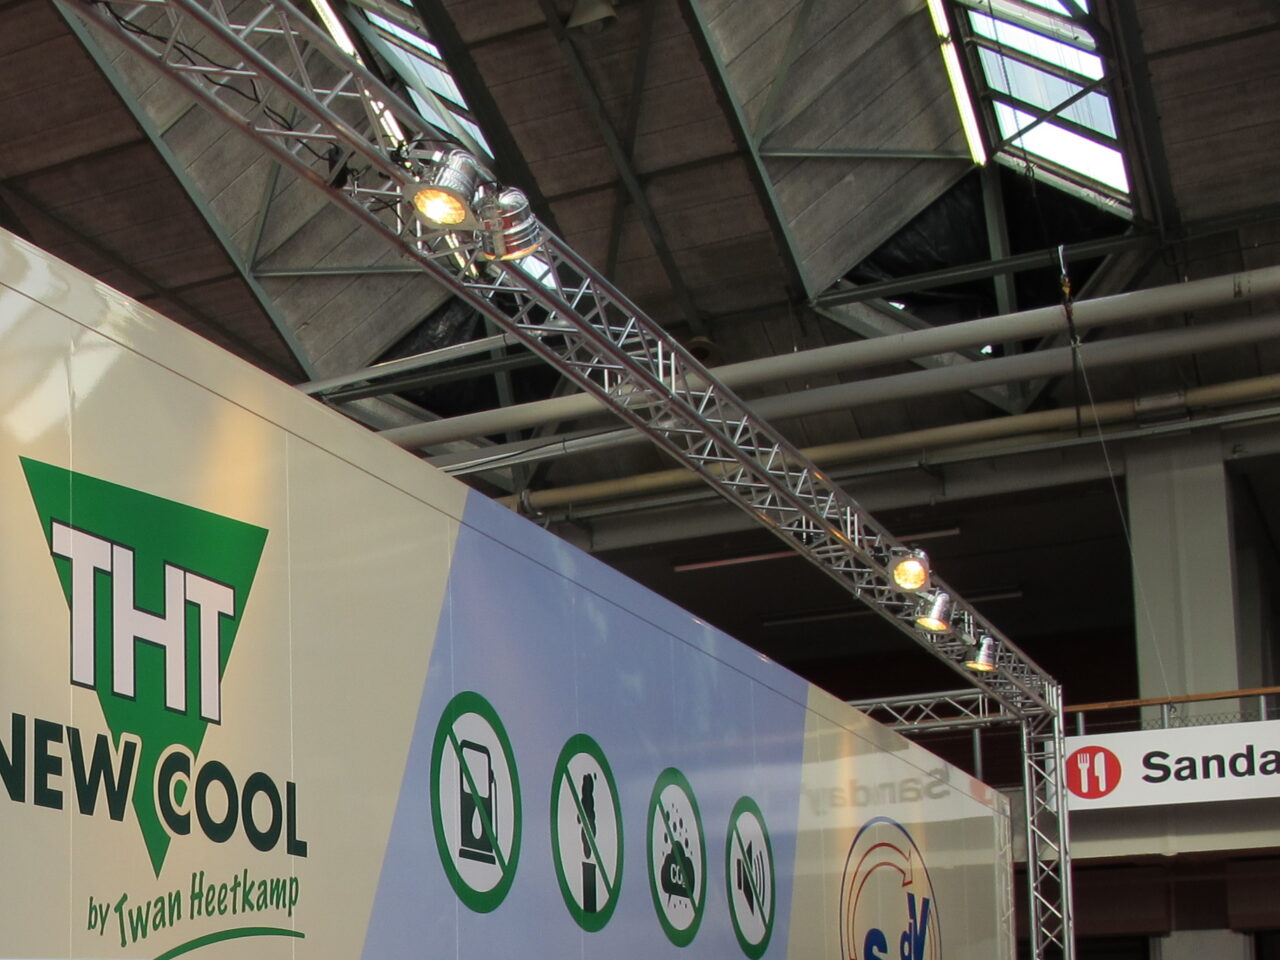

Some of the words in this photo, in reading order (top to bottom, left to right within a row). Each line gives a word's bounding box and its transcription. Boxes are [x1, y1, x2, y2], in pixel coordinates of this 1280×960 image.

[49, 515, 236, 726] THT
[157, 750, 308, 859] COOL
[88, 896, 111, 937] by
[113, 889, 183, 948] Twan
[189, 868, 300, 920] Heetkamp
